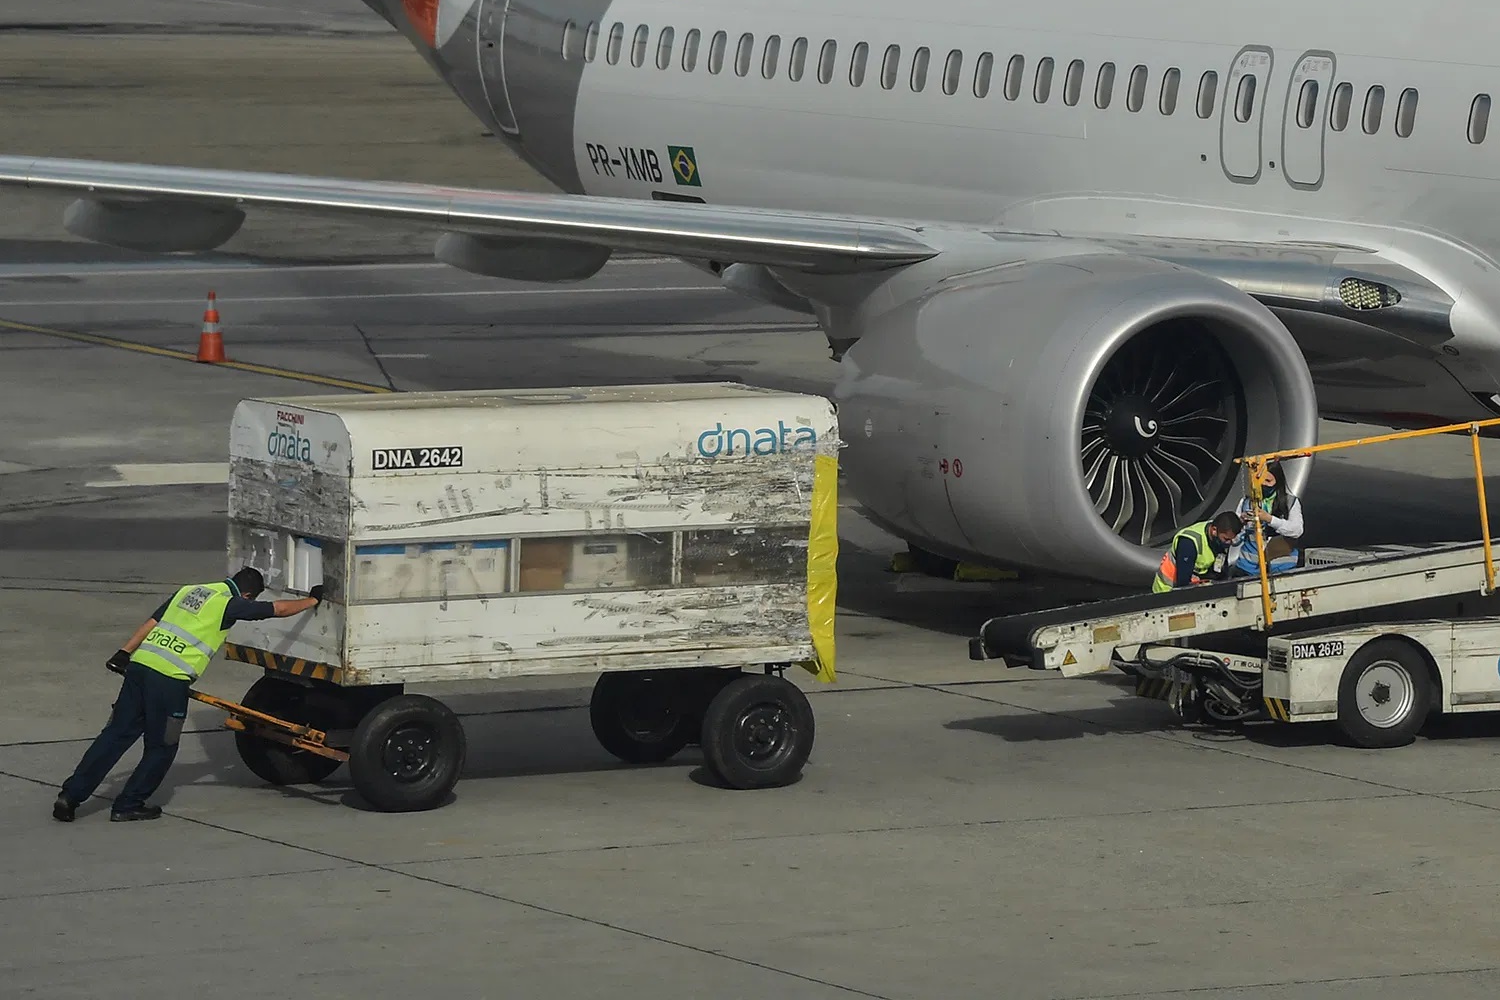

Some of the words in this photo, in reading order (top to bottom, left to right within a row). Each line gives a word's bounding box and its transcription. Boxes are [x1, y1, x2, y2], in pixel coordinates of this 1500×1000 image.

[586, 142, 663, 183] PR-XMB
[277, 410, 305, 424] FACCHINI
[268, 426, 311, 461] dnata
[697, 420, 817, 457] dnata
[374, 449, 415, 469] DNA
[419, 448, 461, 467] 2642
[146, 629, 187, 654] dnata
[1293, 644, 1316, 659] DNA
[1318, 642, 1342, 657] 2679
